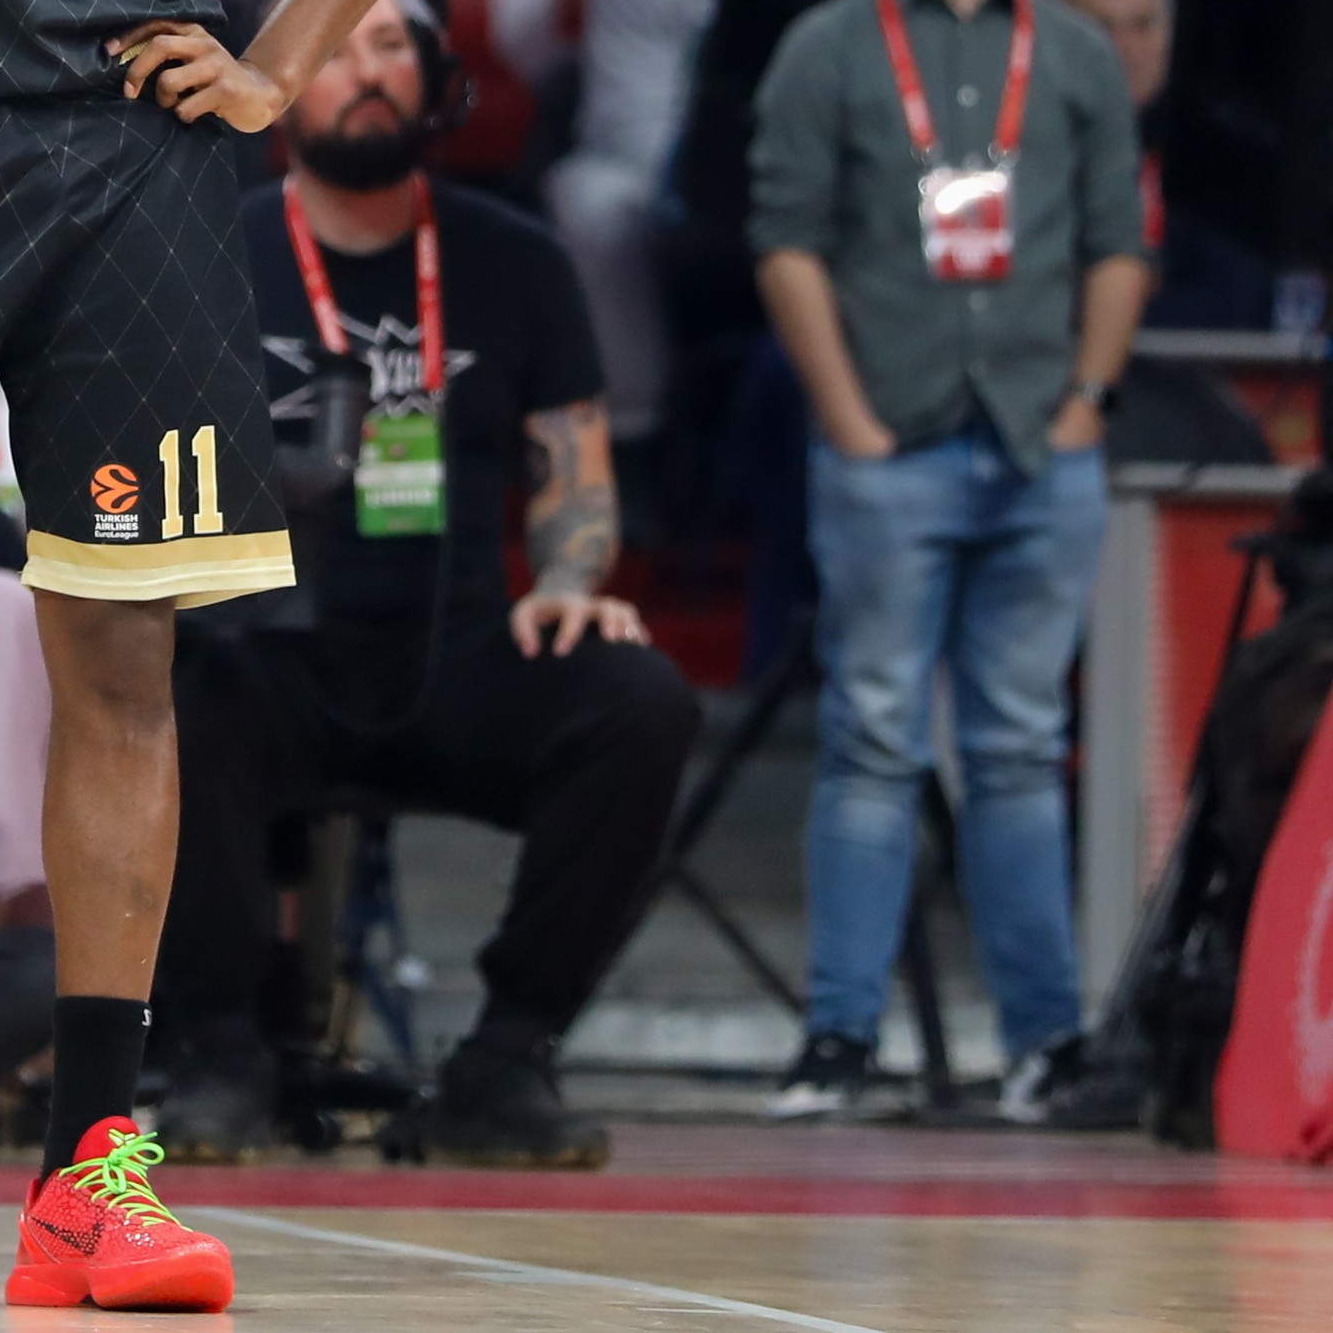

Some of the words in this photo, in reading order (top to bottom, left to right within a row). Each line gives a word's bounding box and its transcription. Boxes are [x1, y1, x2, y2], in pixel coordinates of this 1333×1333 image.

[159, 425, 223, 539] 11
[95, 514, 138, 522] TURKISH
[95, 522, 138, 531] AIRLINES
[95, 531, 139, 541] EuroLeague
